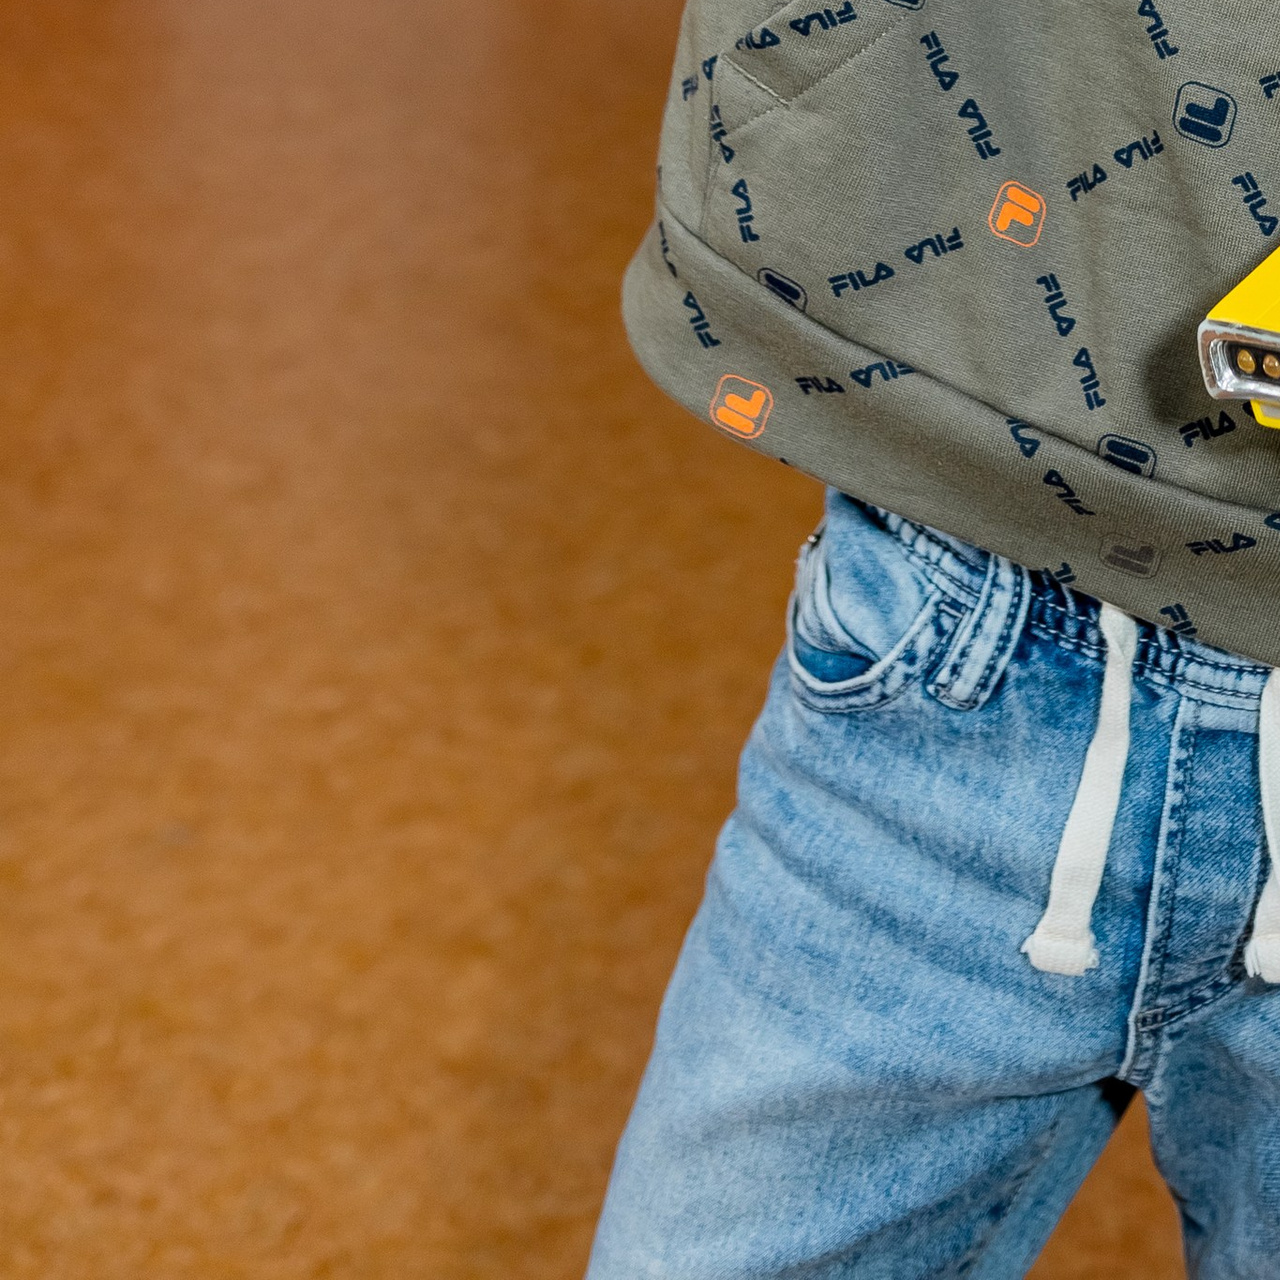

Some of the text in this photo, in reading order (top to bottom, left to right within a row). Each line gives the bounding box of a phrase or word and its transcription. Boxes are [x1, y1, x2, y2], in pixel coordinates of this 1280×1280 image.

[789, 1, 859, 37] FILA
[920, 31, 961, 93] FILA
[958, 99, 1003, 162] FILA
[1114, 133, 1165, 170] FILA
[1067, 165, 1109, 202] FILA
[1232, 172, 1280, 238] FILA
[732, 179, 761, 244] FILA
[904, 228, 965, 266] FILA
[829, 262, 897, 299] FILA
[684, 294, 722, 350] FILA
[1036, 273, 1078, 338] FILA
[1073, 348, 1108, 412] FILA
[1178, 410, 1237, 448] FILA
[1185, 531, 1258, 557] FILA
